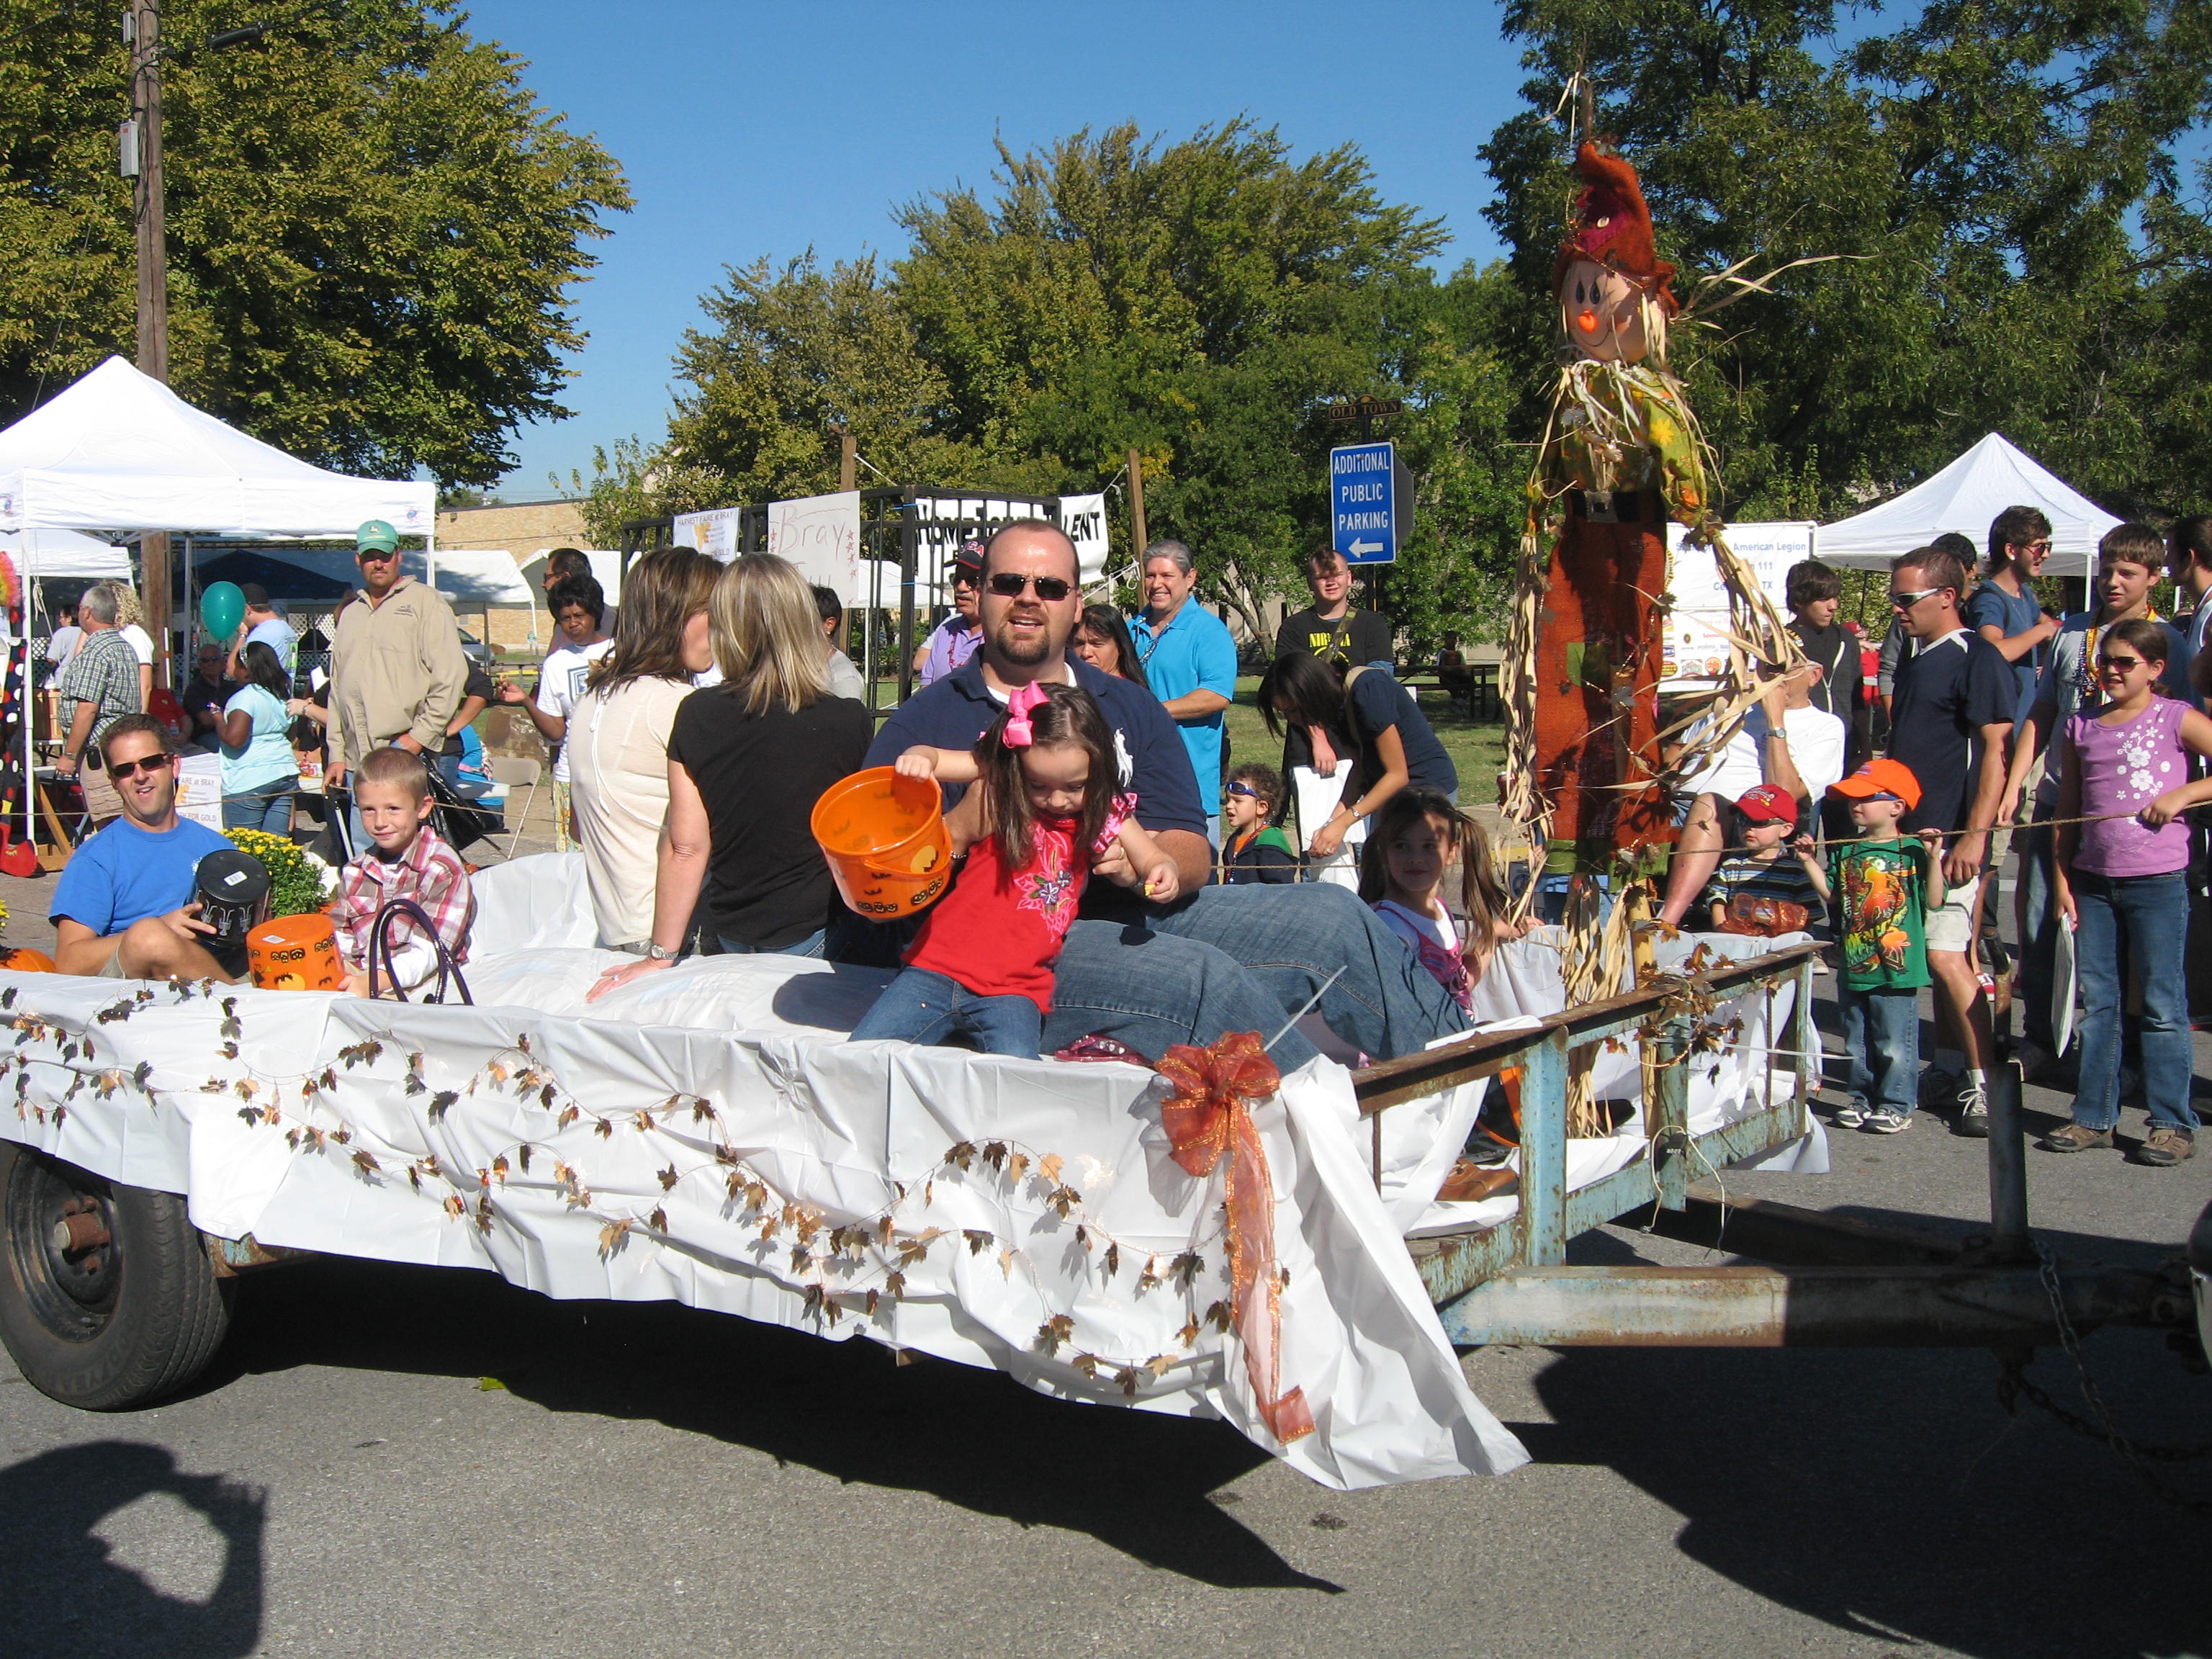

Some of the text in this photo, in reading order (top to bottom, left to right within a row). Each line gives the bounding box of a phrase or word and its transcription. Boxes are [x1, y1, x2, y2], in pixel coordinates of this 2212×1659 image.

[1332, 402, 1399, 418] OLD TOWN
[1334, 451, 1390, 475] ADDITIONAL
[1341, 482, 1383, 503] PUBLIC
[719, 511, 733, 519] BRAY
[1339, 511, 1389, 531] PARKING
[778, 504, 846, 561] Bray
[1733, 542, 1773, 551] American
[1776, 541, 1806, 552] Legion
[1758, 562, 1773, 570] 111
[1762, 581, 1773, 590] TX
[201, 814, 217, 822] GOLD
